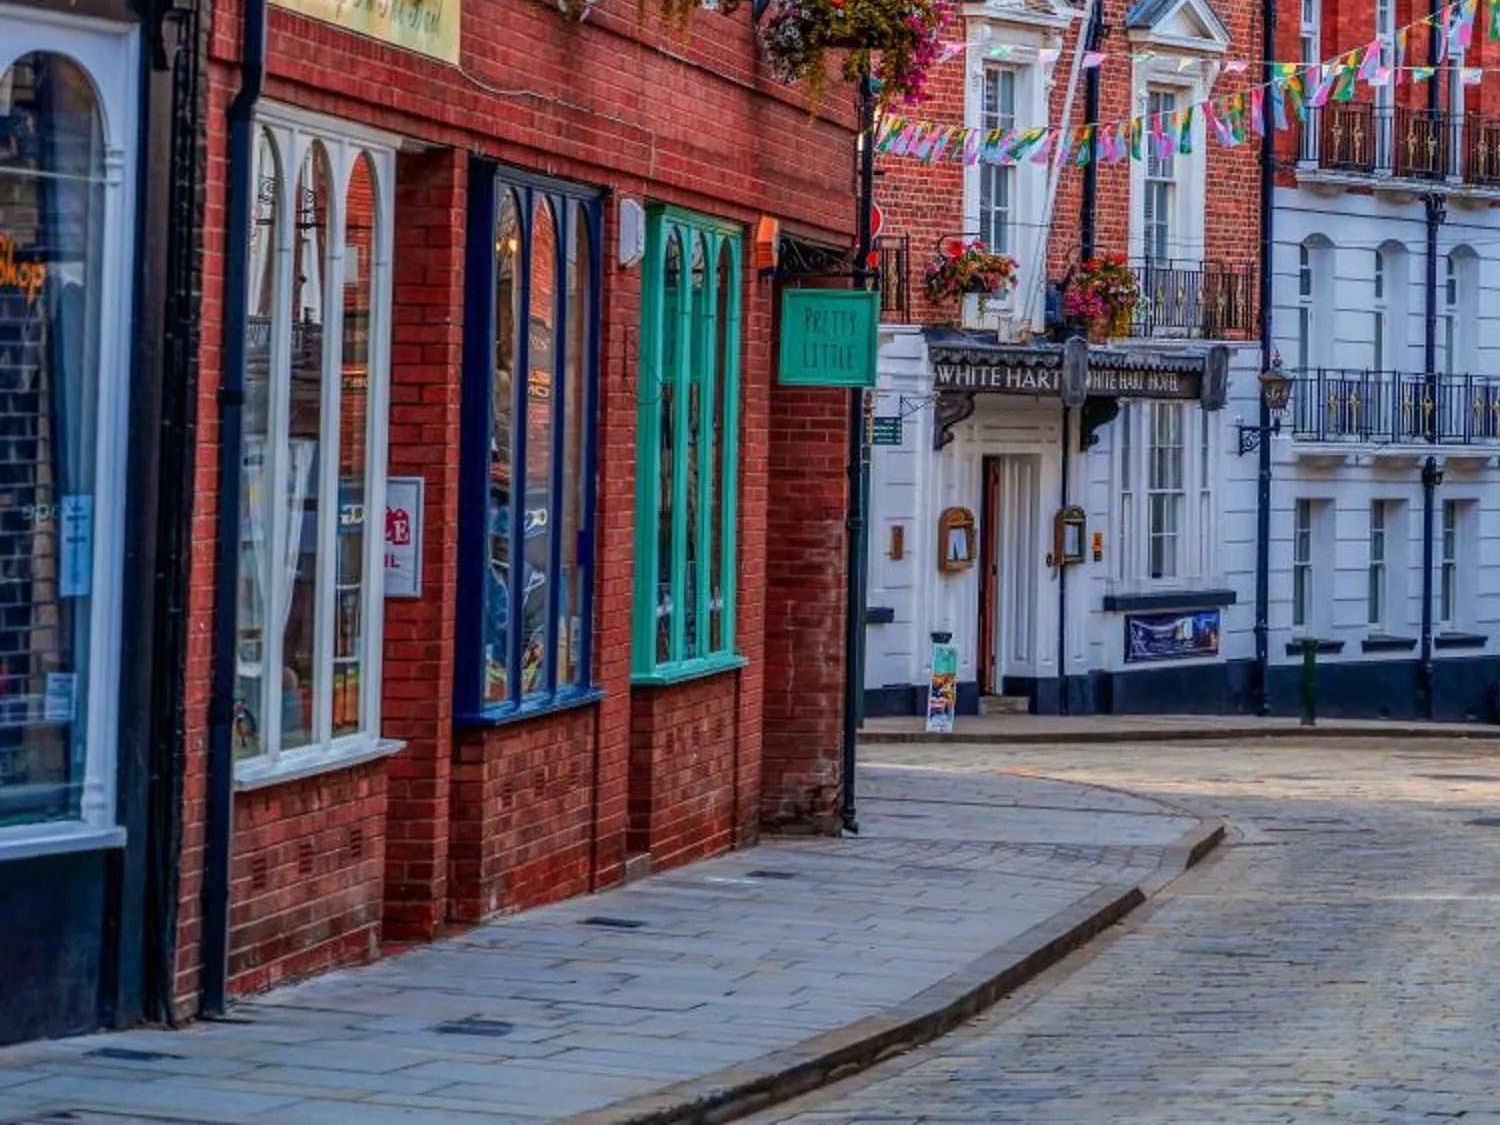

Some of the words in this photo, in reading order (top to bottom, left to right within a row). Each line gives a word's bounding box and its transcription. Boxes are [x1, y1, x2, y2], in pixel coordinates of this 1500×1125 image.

[0, 231, 46, 307] hop
[803, 307, 858, 335] PRETTY
[803, 340, 855, 371] LITTLE
[937, 364, 1001, 387] WHITE
[1006, 368, 1061, 390] HART
